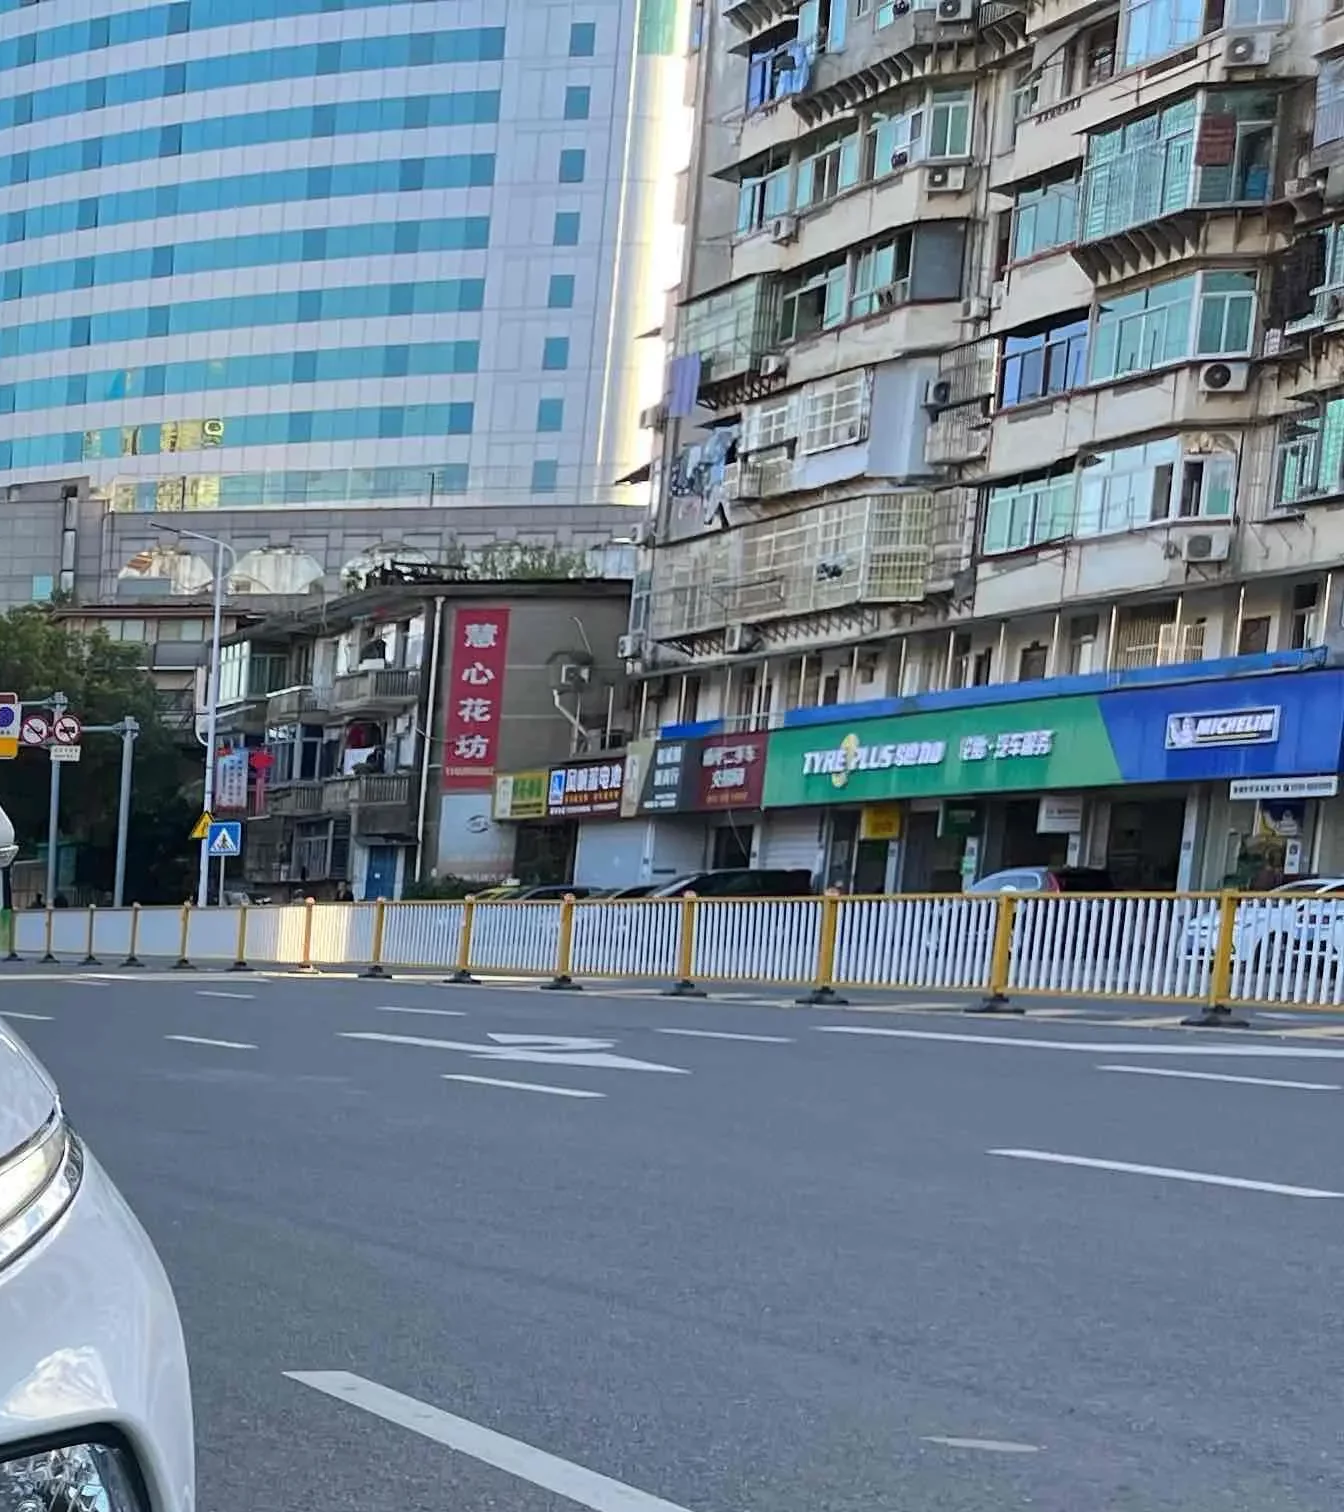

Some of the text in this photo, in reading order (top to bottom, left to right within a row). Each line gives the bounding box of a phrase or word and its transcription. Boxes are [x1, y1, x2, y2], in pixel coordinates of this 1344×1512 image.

[454, 623, 499, 760] 慧心花坊
[1196, 711, 1275, 736] MICHELIN
